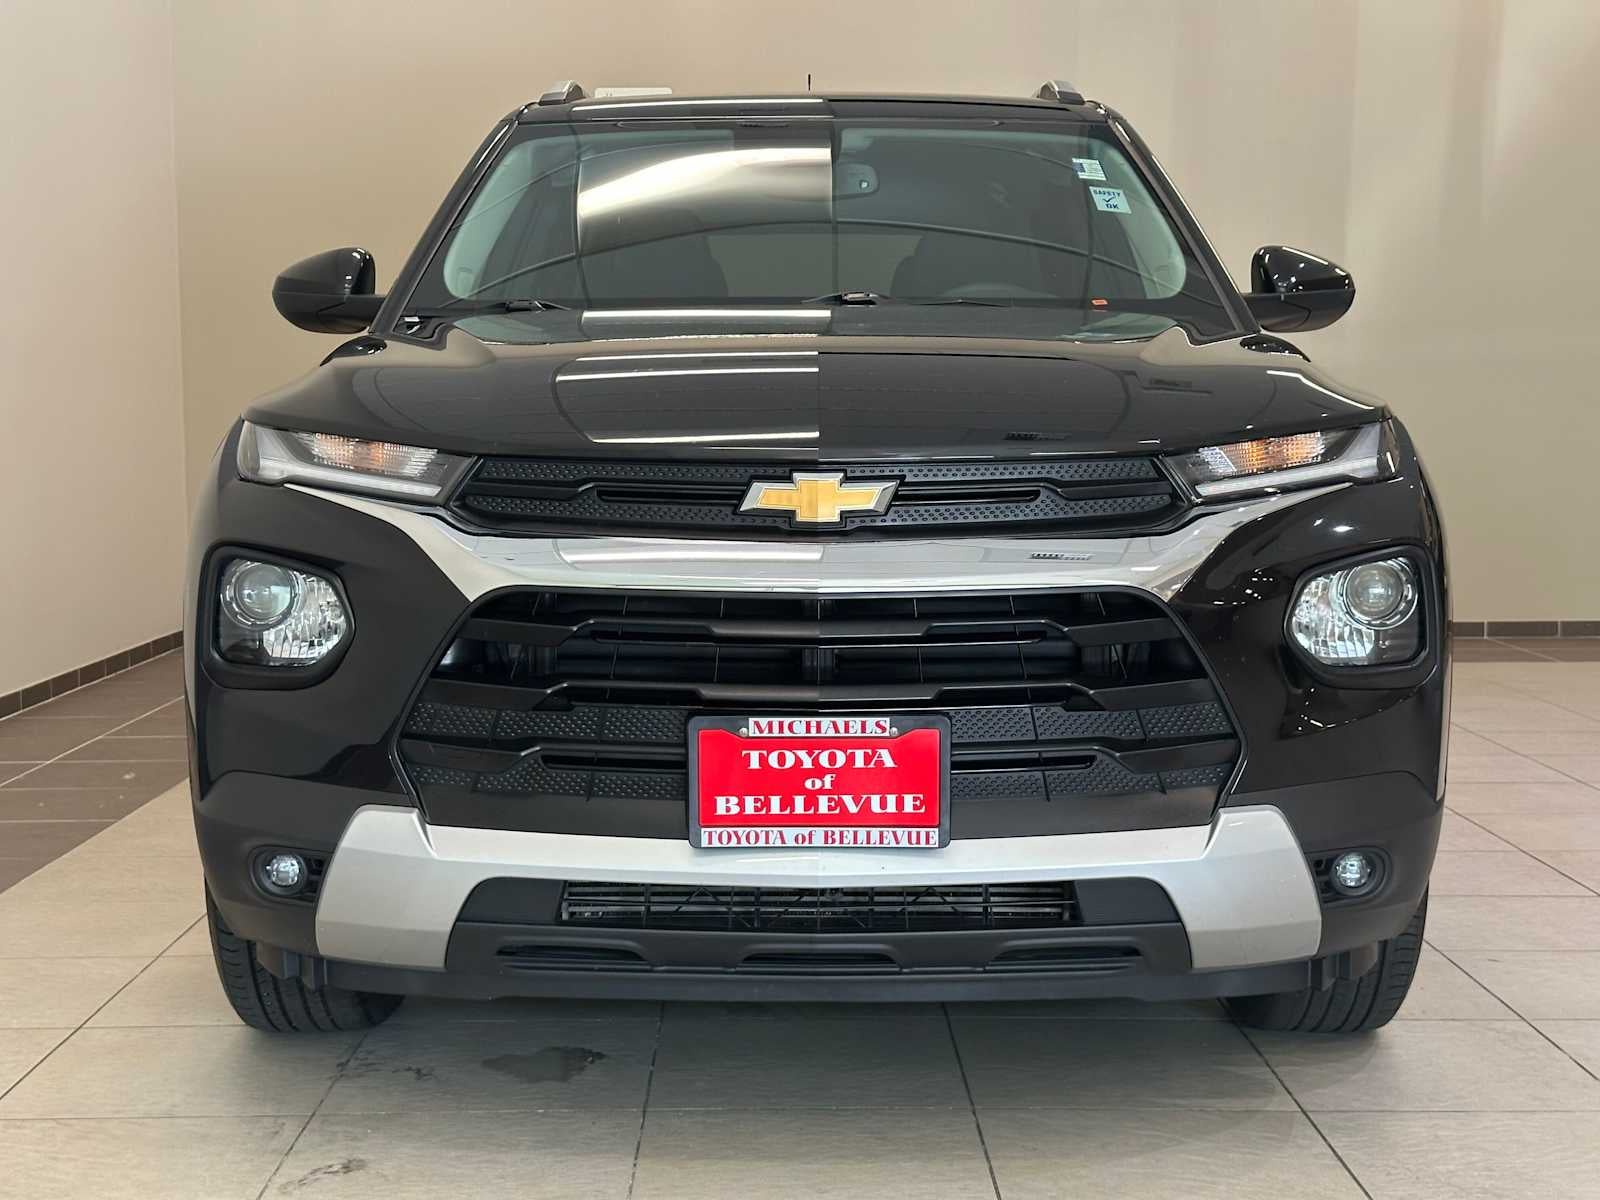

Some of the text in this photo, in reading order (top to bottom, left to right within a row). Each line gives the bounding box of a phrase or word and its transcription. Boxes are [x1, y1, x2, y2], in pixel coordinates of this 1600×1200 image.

[752, 719, 887, 735] MICHAELS
[741, 748, 898, 769] TOYOTA
[804, 773, 836, 790] of
[714, 793, 926, 816] BELLEVUE
[703, 829, 937, 846] TOYOTA of BELLEVUE
